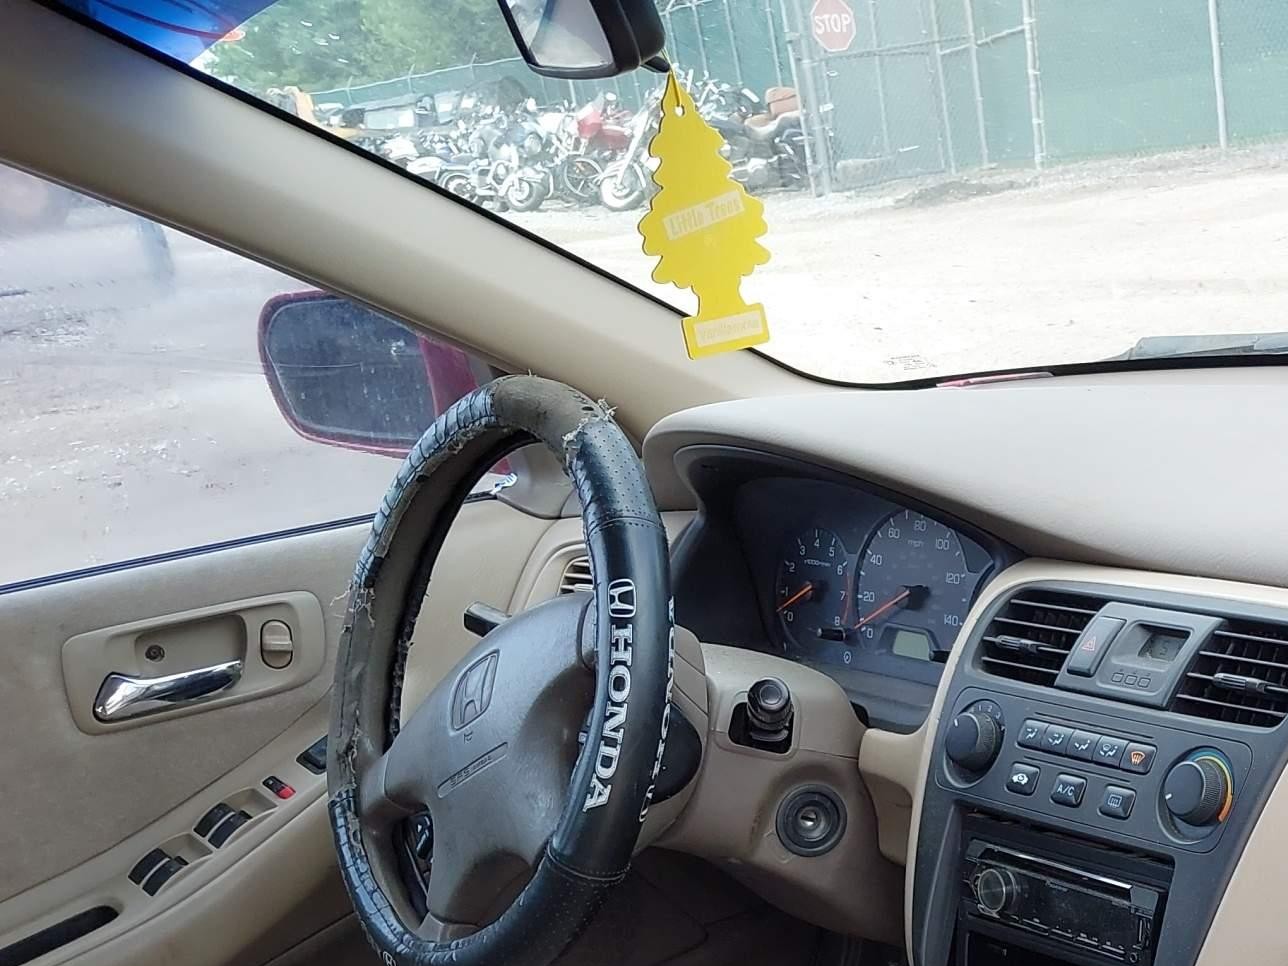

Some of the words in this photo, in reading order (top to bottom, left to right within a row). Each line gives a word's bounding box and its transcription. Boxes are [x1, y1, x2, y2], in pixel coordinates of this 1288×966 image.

[814, 14, 851, 34] STOP
[914, 520, 926, 532] 80
[888, 527, 900, 539] 60
[814, 538, 820, 548] 4
[935, 538, 949, 551] 100
[800, 545, 806, 556] 3
[829, 546, 835, 557] 5
[870, 554, 882, 566] 40
[790, 562, 796, 573] 2
[837, 564, 843, 576] 6
[945, 572, 960, 585] 120
[840, 590, 846, 601] 7
[863, 591, 875, 602] 20
[787, 611, 794, 622] 0
[834, 616, 840, 626] 8
[943, 614, 959, 627] 140
[866, 627, 873, 638] 0
[582, 624, 633, 812] HONDA
[1056, 784, 1075, 796] A/C
